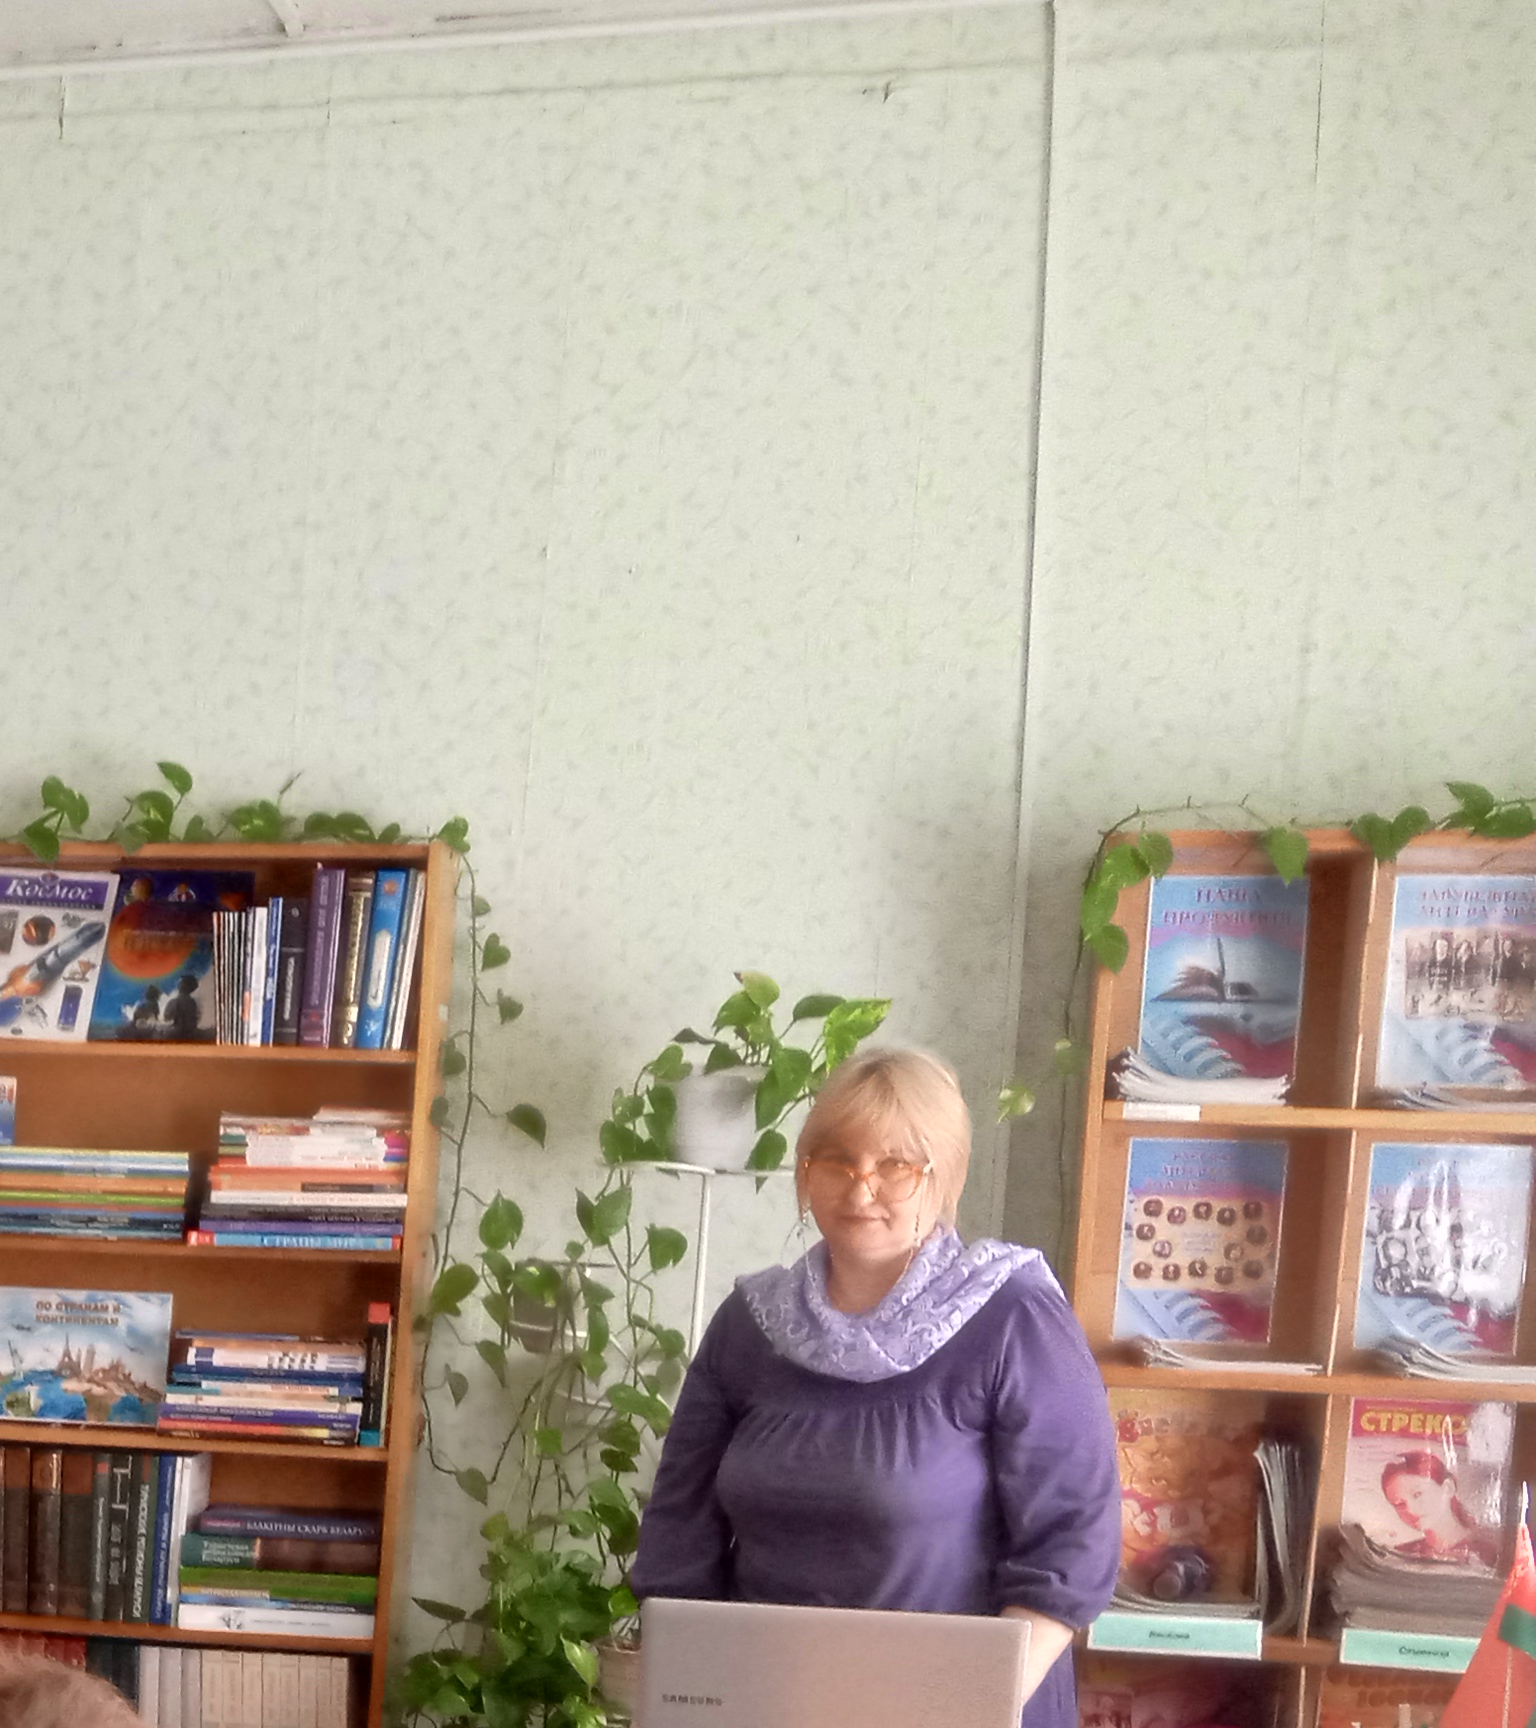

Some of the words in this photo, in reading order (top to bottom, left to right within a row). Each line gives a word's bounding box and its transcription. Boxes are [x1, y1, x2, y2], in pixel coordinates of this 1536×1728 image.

[3, 874, 95, 901] Космос
[1360, 1411, 1468, 1436] СТРЕКО
[661, 1693, 723, 1706] SAMSUNG
